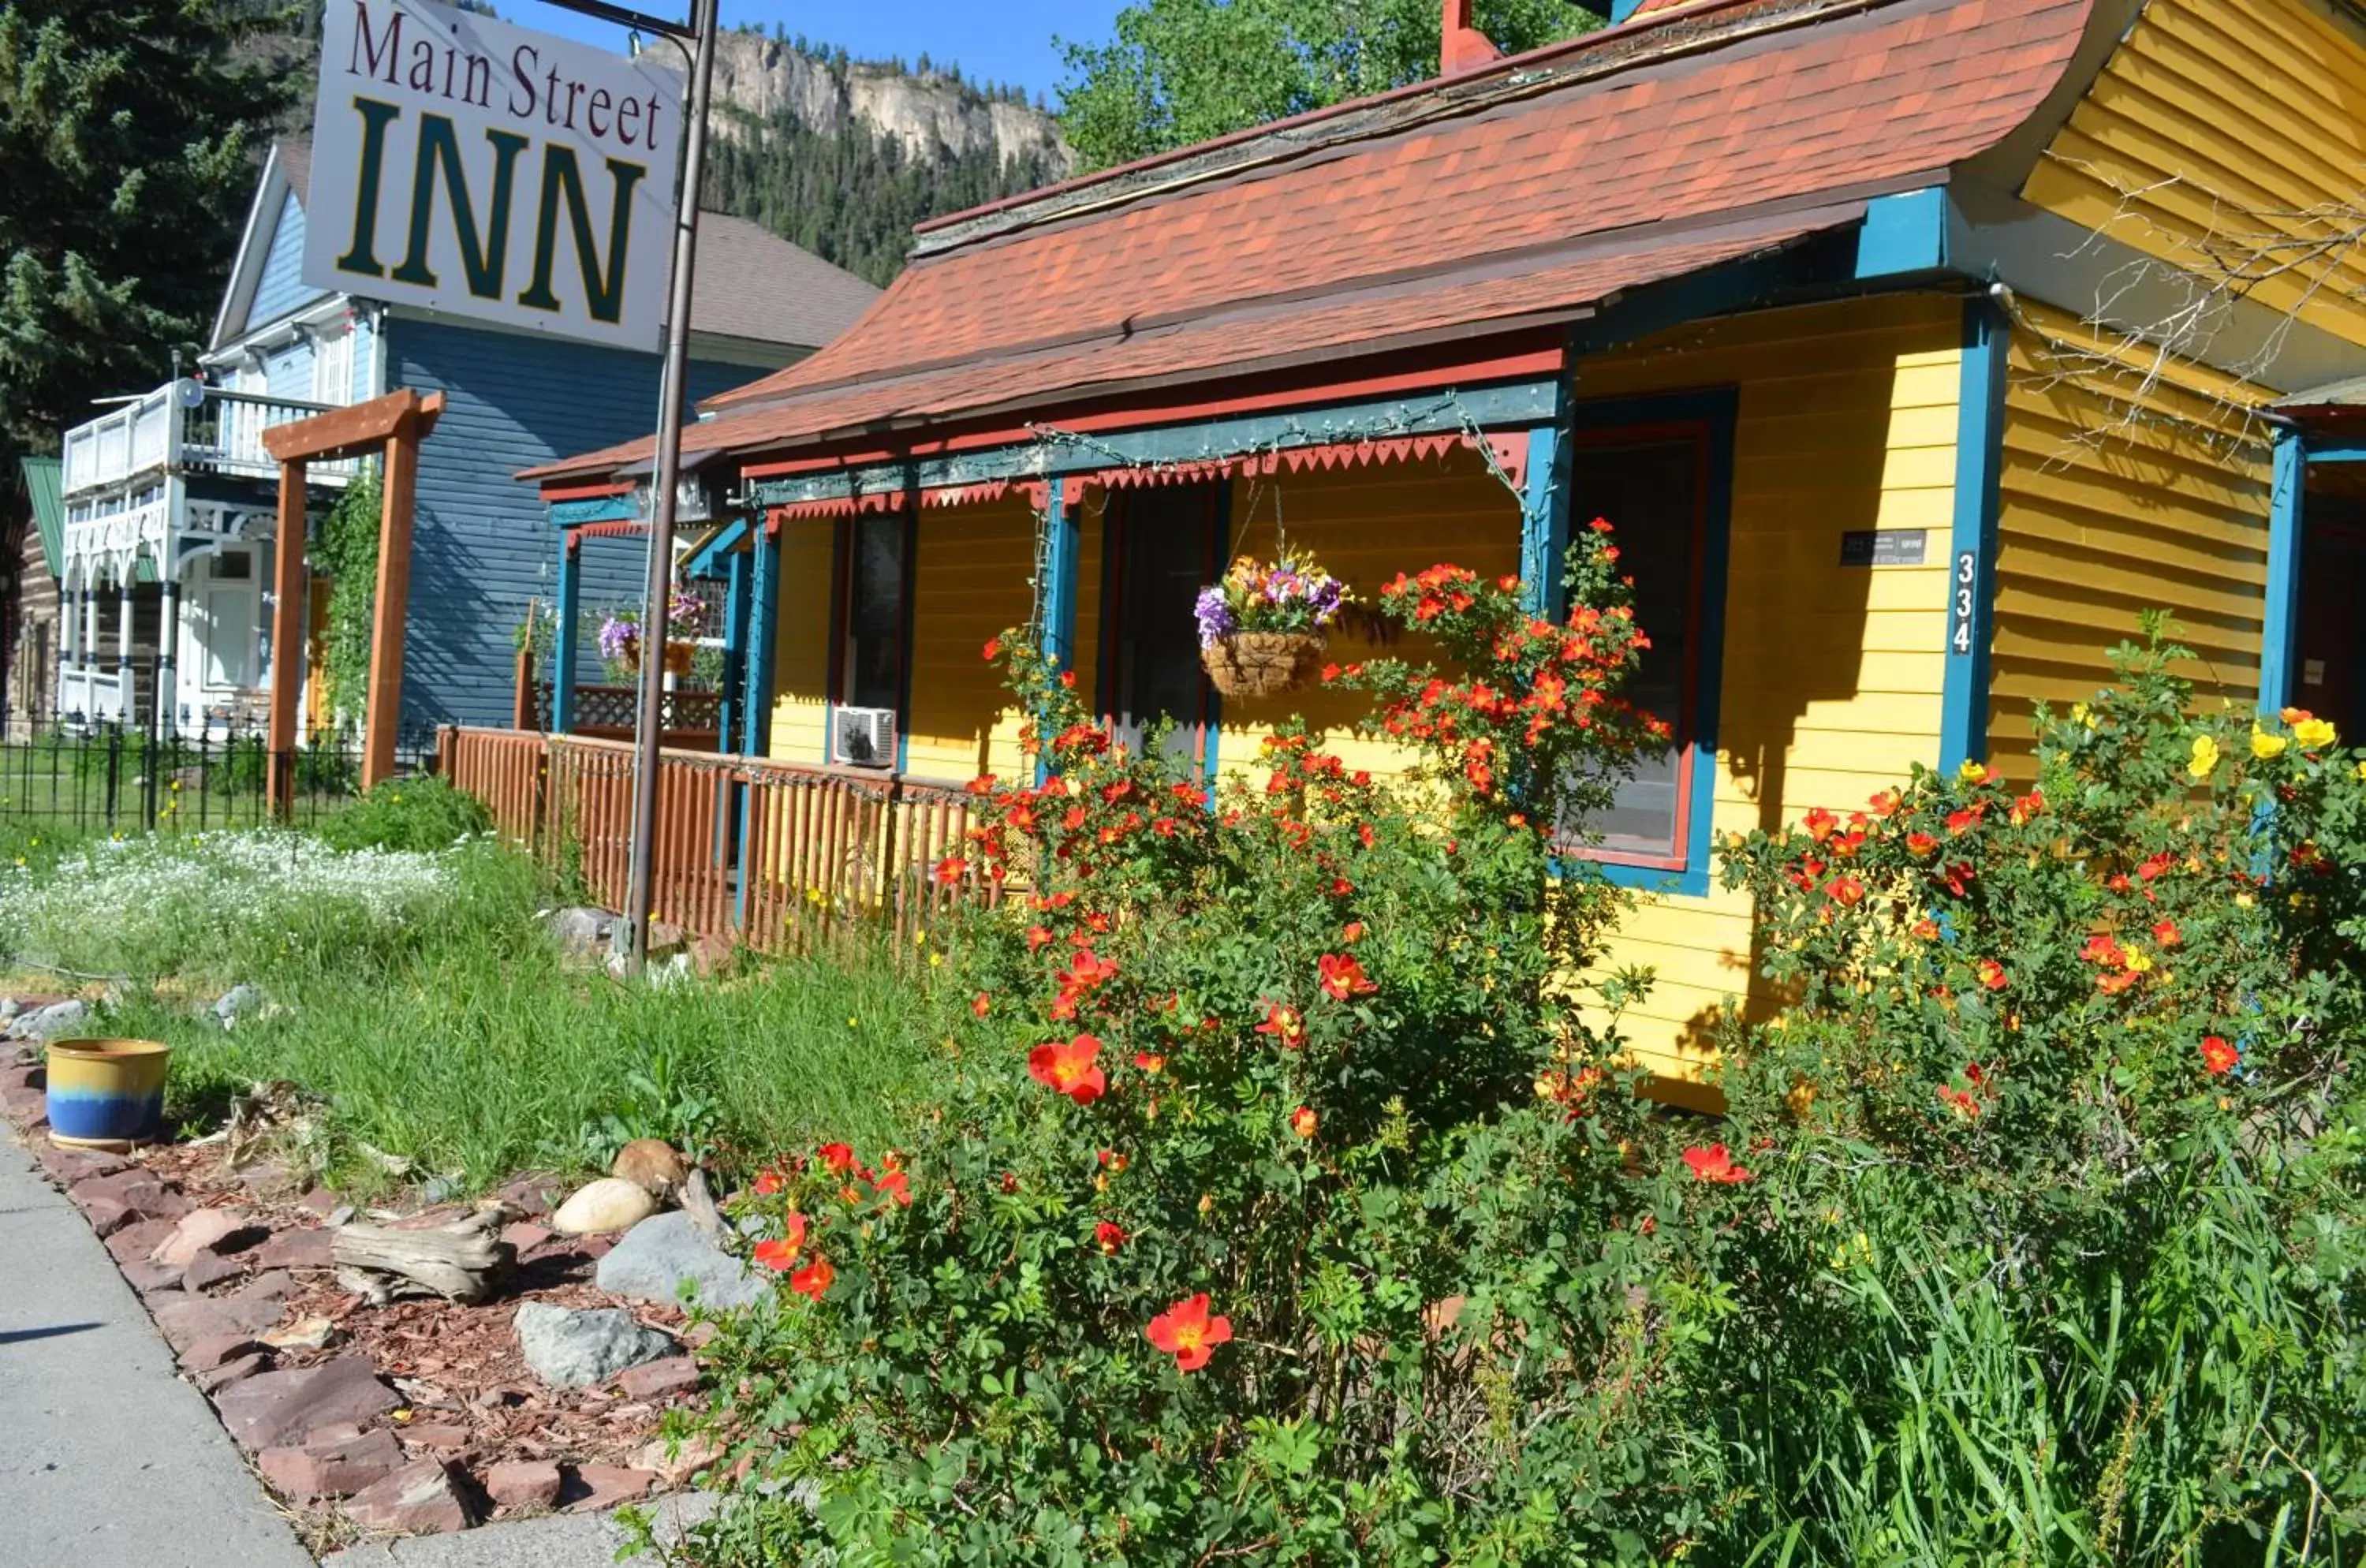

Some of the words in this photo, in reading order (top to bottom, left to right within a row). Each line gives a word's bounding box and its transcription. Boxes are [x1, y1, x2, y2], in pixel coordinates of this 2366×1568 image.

[345, 1, 492, 108] Main
[508, 43, 661, 150] Street
[336, 95, 646, 324] INN
[1954, 554, 1973, 651] 334
